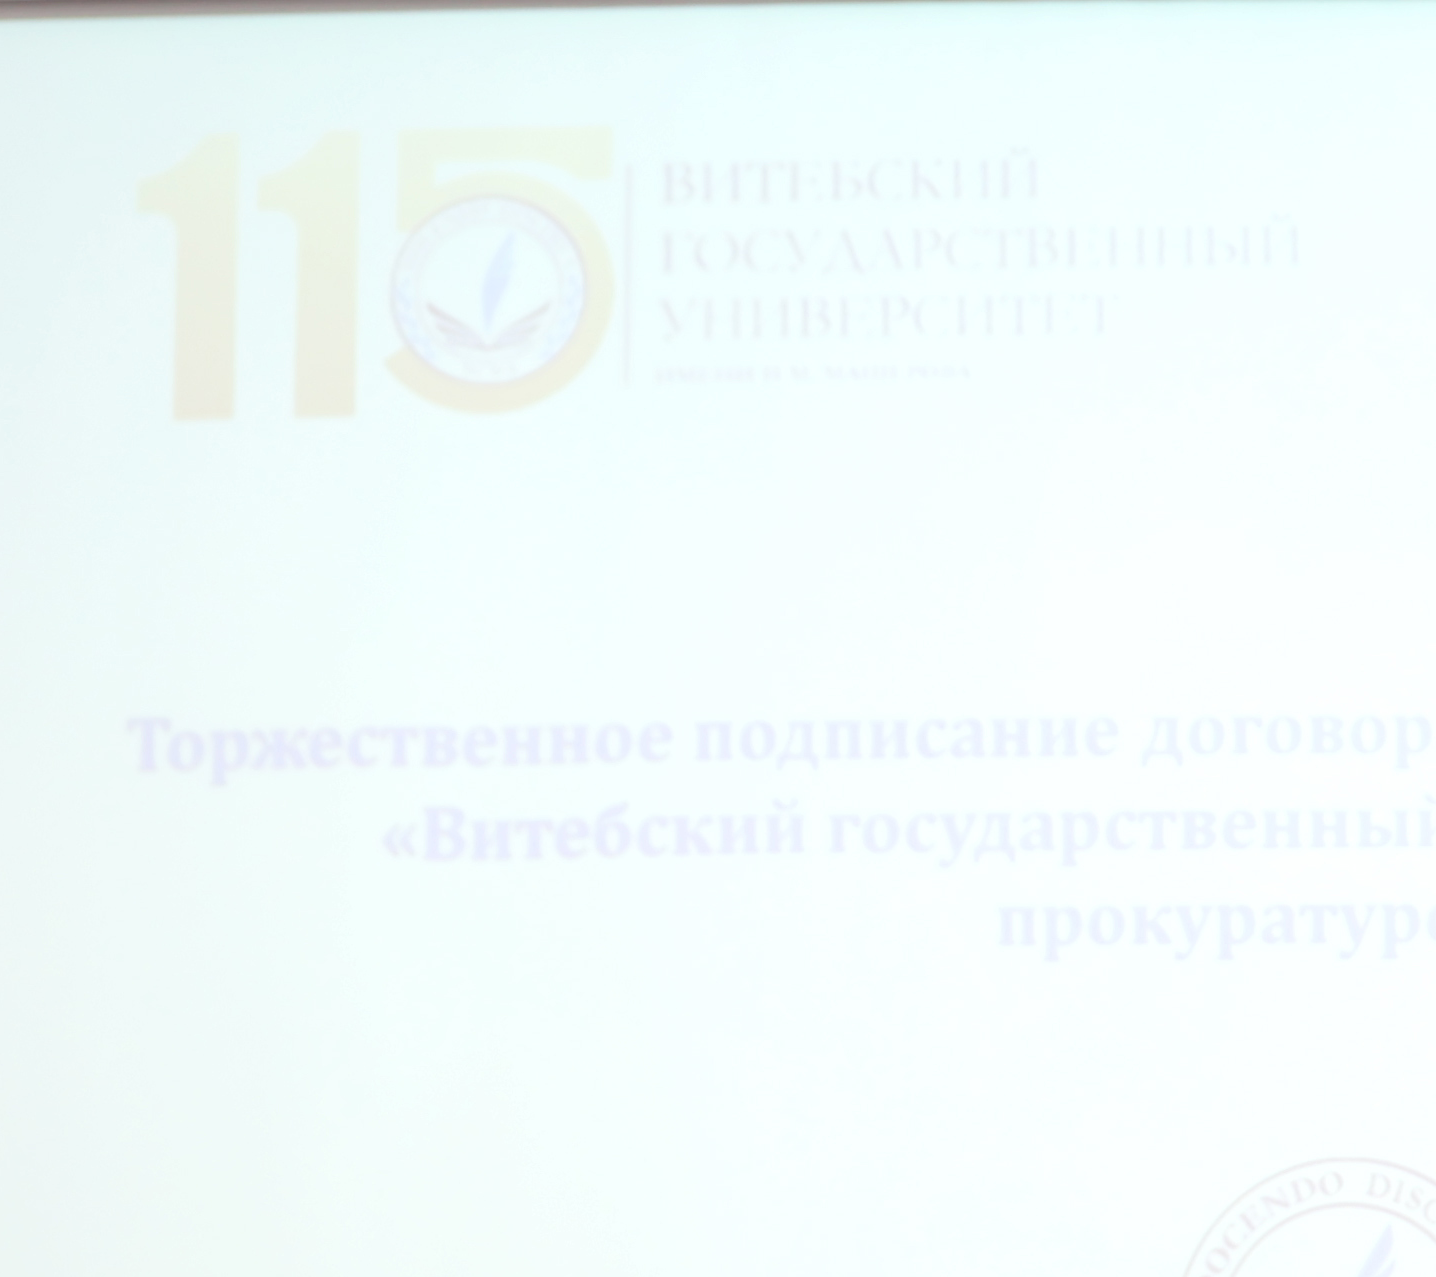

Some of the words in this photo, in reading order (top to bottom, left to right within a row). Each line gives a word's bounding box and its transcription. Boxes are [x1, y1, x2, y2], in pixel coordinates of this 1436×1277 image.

[663, 148, 1037, 206] ВИТЕБСКИЙ
[135, 126, 614, 421] 115
[660, 213, 1300, 279] ГОСУДАРСТВЕННЫЙ
[660, 291, 1116, 340] УНИВЕРСИТЕТ
[127, 715, 674, 788] Торжественное
[690, 705, 1118, 770] подписание
[379, 797, 806, 863] «Витебский
